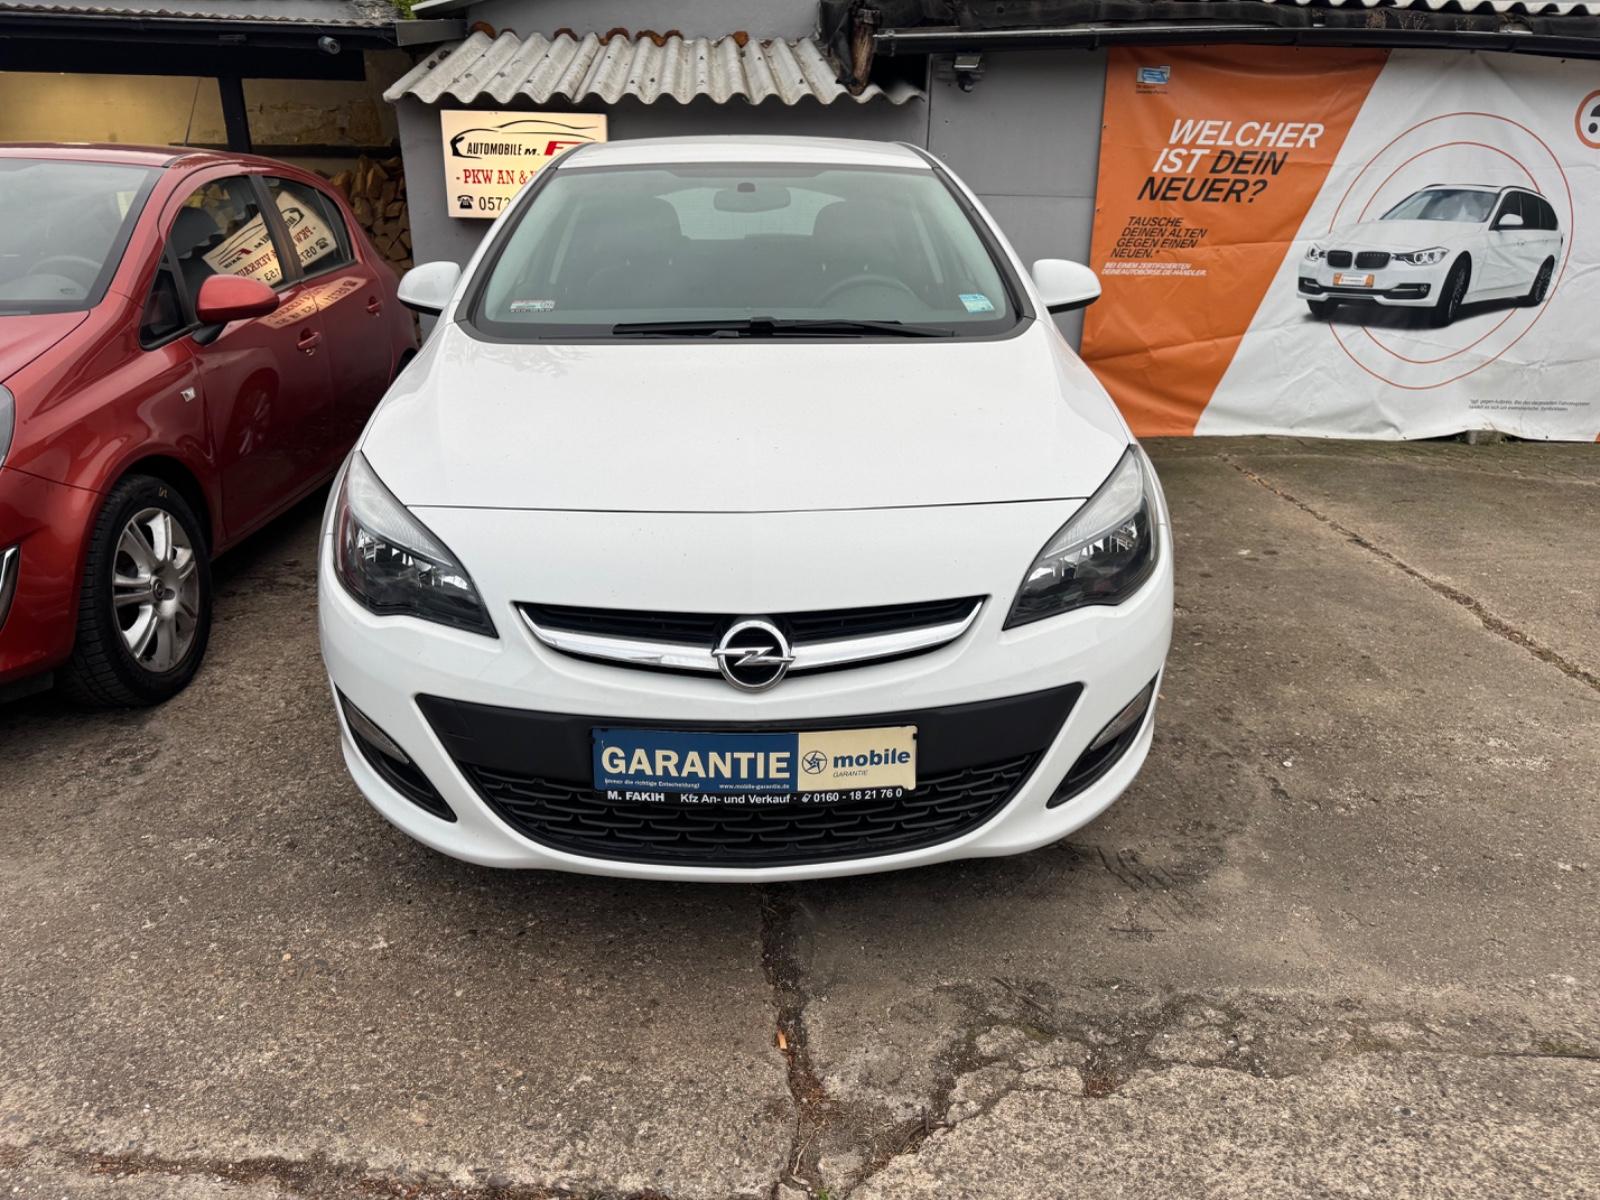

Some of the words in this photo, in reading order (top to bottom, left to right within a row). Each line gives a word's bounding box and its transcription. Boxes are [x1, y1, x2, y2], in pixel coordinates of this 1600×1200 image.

[1168, 118, 1325, 149] WELCHER
[467, 142, 522, 157] AUTOMOBILE
[524, 148, 541, 157] M.
[1153, 148, 1211, 174] IST
[1209, 149, 1289, 176] DEIN
[463, 168, 494, 185] PKW
[497, 169, 515, 185] AN
[518, 170, 529, 185] &
[1136, 176, 1269, 203] NEUER?
[1127, 216, 1185, 228] TAUSCHE
[1121, 227, 1168, 238] DEINEN
[1167, 227, 1209, 239] ALTEN
[1115, 238, 1160, 248] GEGEN
[1159, 238, 1198, 249] EINEN
[600, 746, 791, 779] GARANTIE
[833, 747, 911, 769] mobile
[607, 790, 623, 801] M.
[625, 791, 665, 802] FAKIH
[680, 793, 699, 803] Kfz
[700, 793, 722, 804] An-
[724, 793, 746, 804] und
[747, 793, 791, 804] Verkauf
[813, 792, 839, 803] 0160
[848, 790, 861, 801] 18
[864, 790, 877, 800] 21
[880, 789, 893, 799] 76
[895, 789, 903, 798] 0
